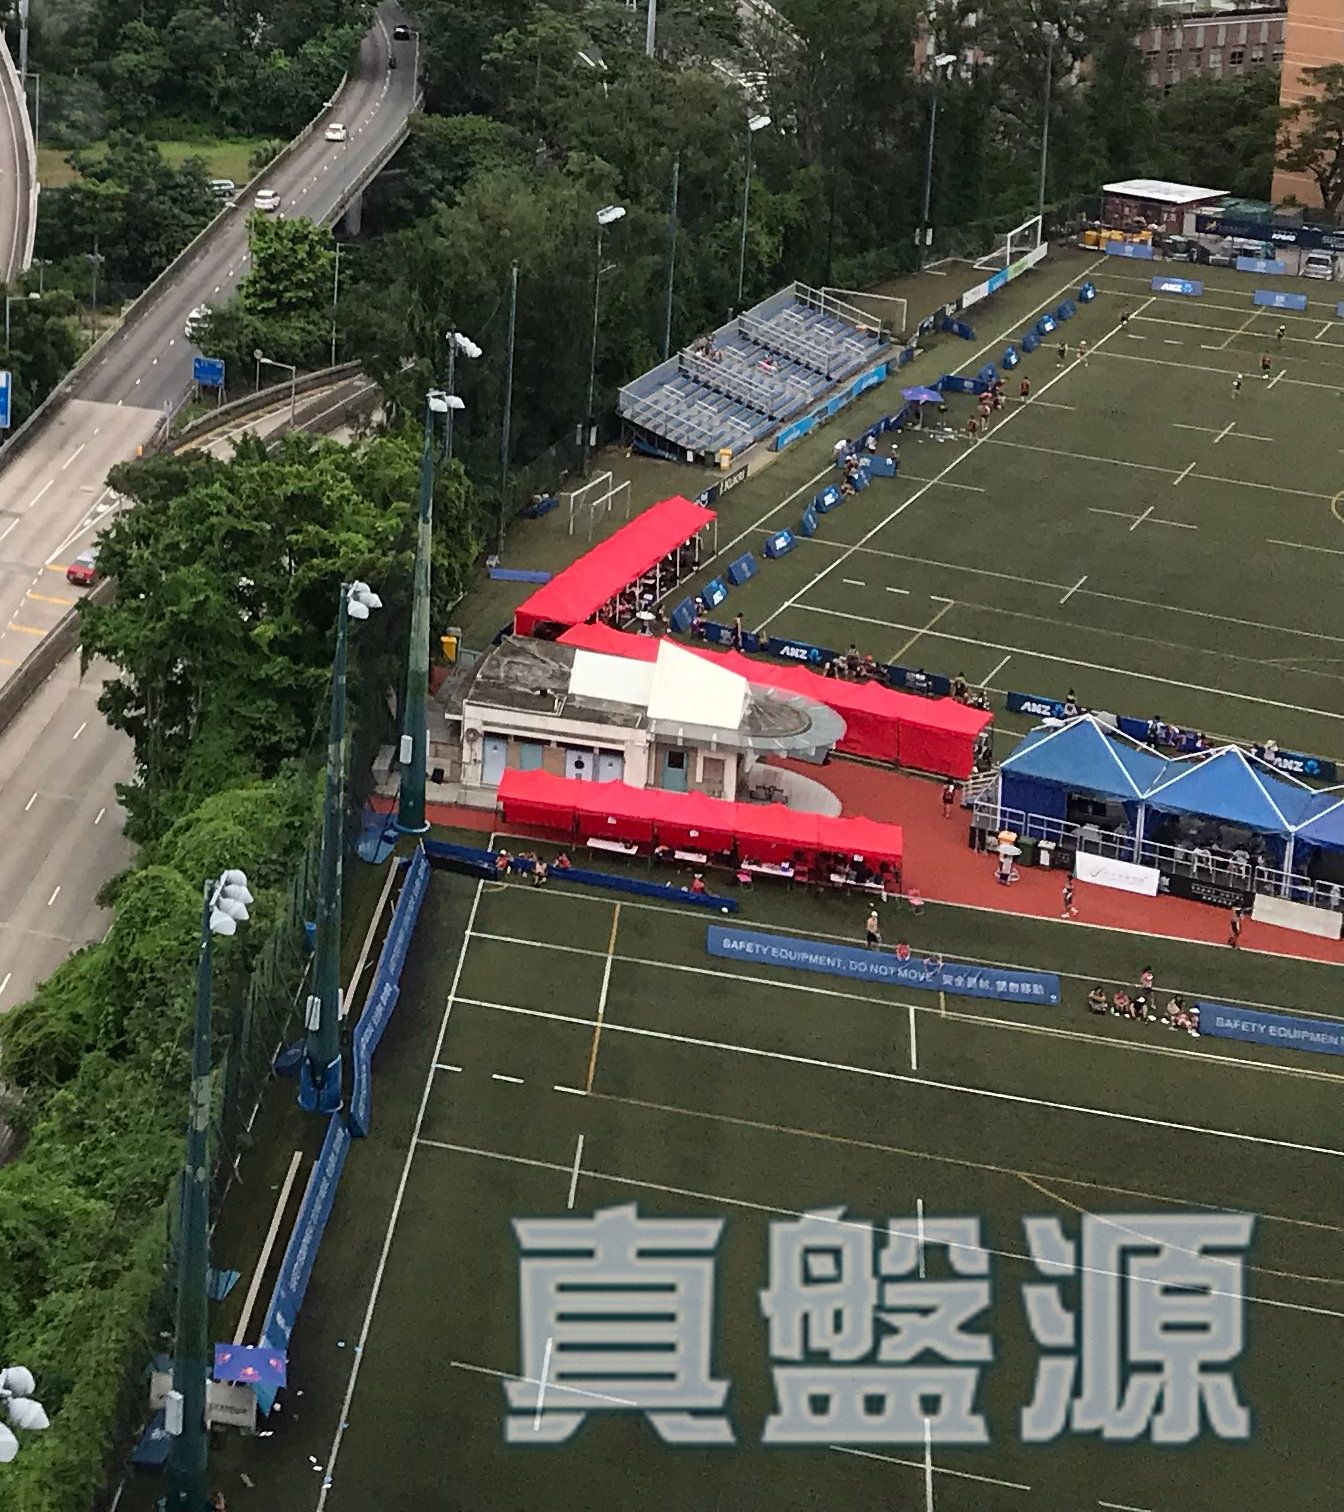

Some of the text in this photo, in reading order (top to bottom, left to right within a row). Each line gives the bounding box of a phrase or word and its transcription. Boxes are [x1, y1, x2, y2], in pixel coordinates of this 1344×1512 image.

[779, 645, 808, 660] ANZ
[1020, 701, 1052, 716] ANZ
[1273, 757, 1304, 773] ANZ
[722, 938, 769, 955] SAFETY
[849, 960, 868, 972] DO
[869, 963, 895, 976] NOT
[897, 967, 933, 983] MOVE
[1215, 1016, 1267, 1034] SAFETY
